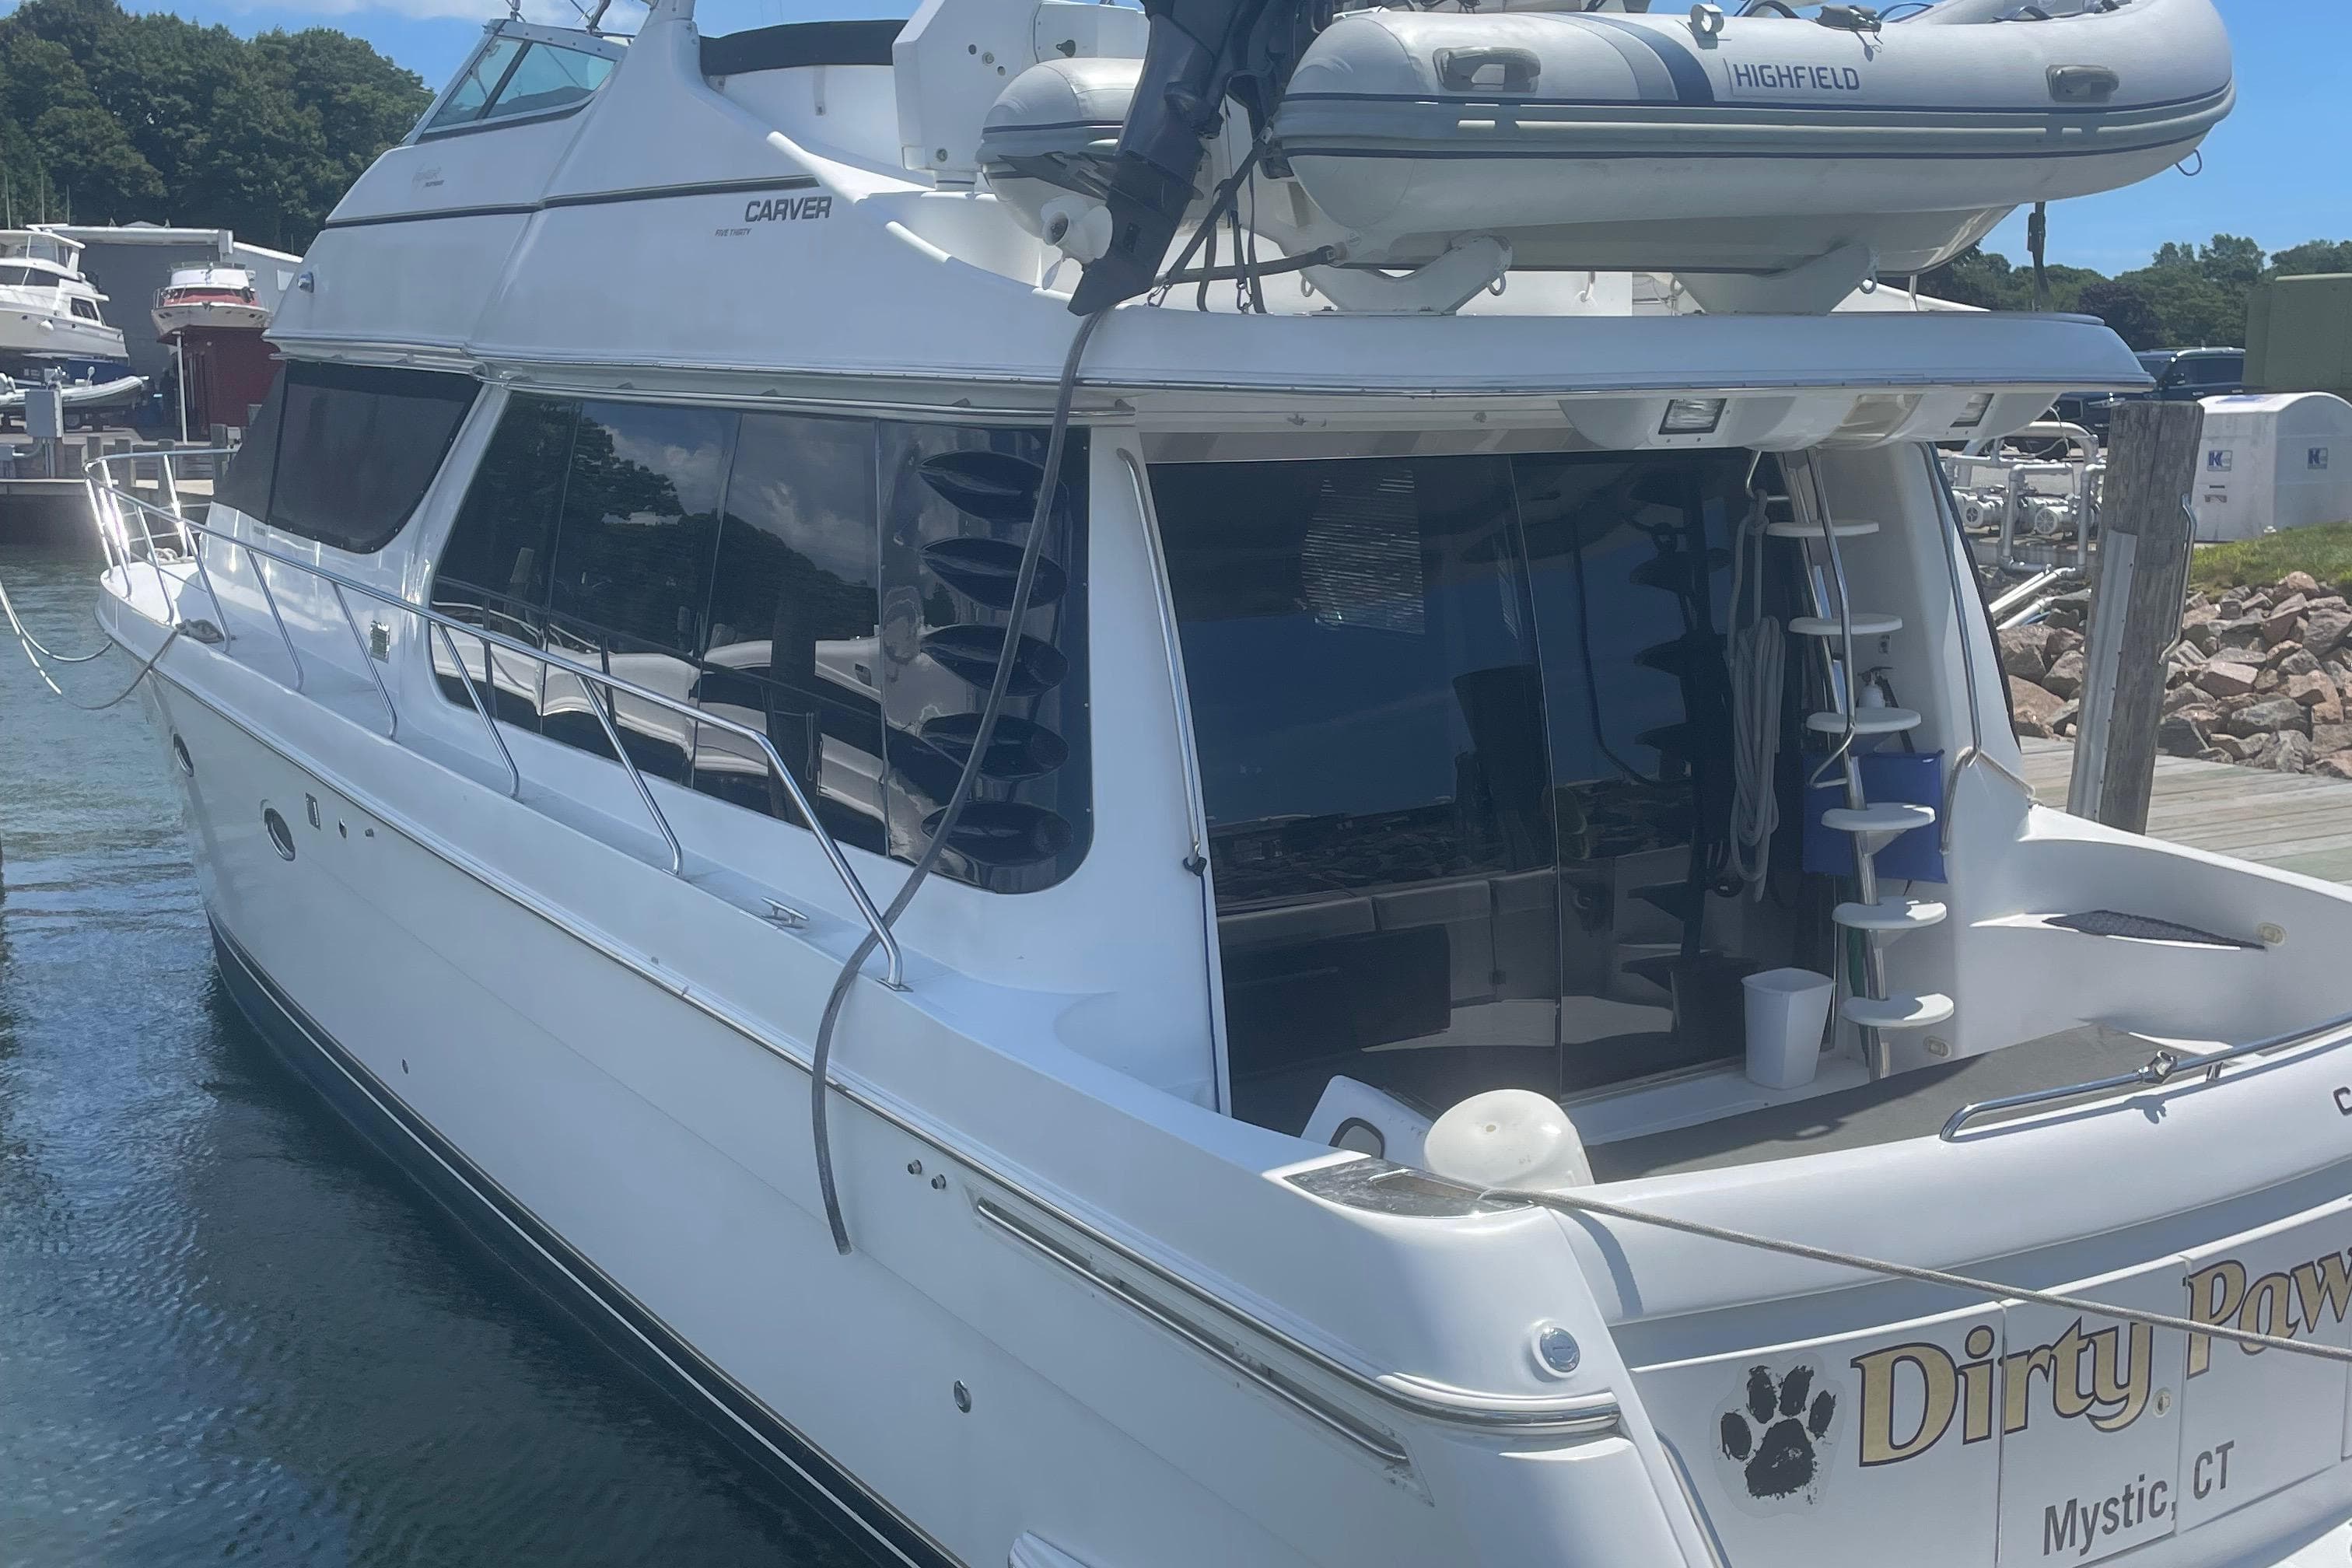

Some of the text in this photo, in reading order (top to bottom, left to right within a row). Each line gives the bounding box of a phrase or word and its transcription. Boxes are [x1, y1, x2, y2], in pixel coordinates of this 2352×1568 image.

[1733, 64, 1860, 90] HIGHFIELD
[744, 196, 832, 222] CARVER
[1850, 1316, 2154, 1467] Dirty
[2043, 1440, 2235, 1556] Mystic, CT
